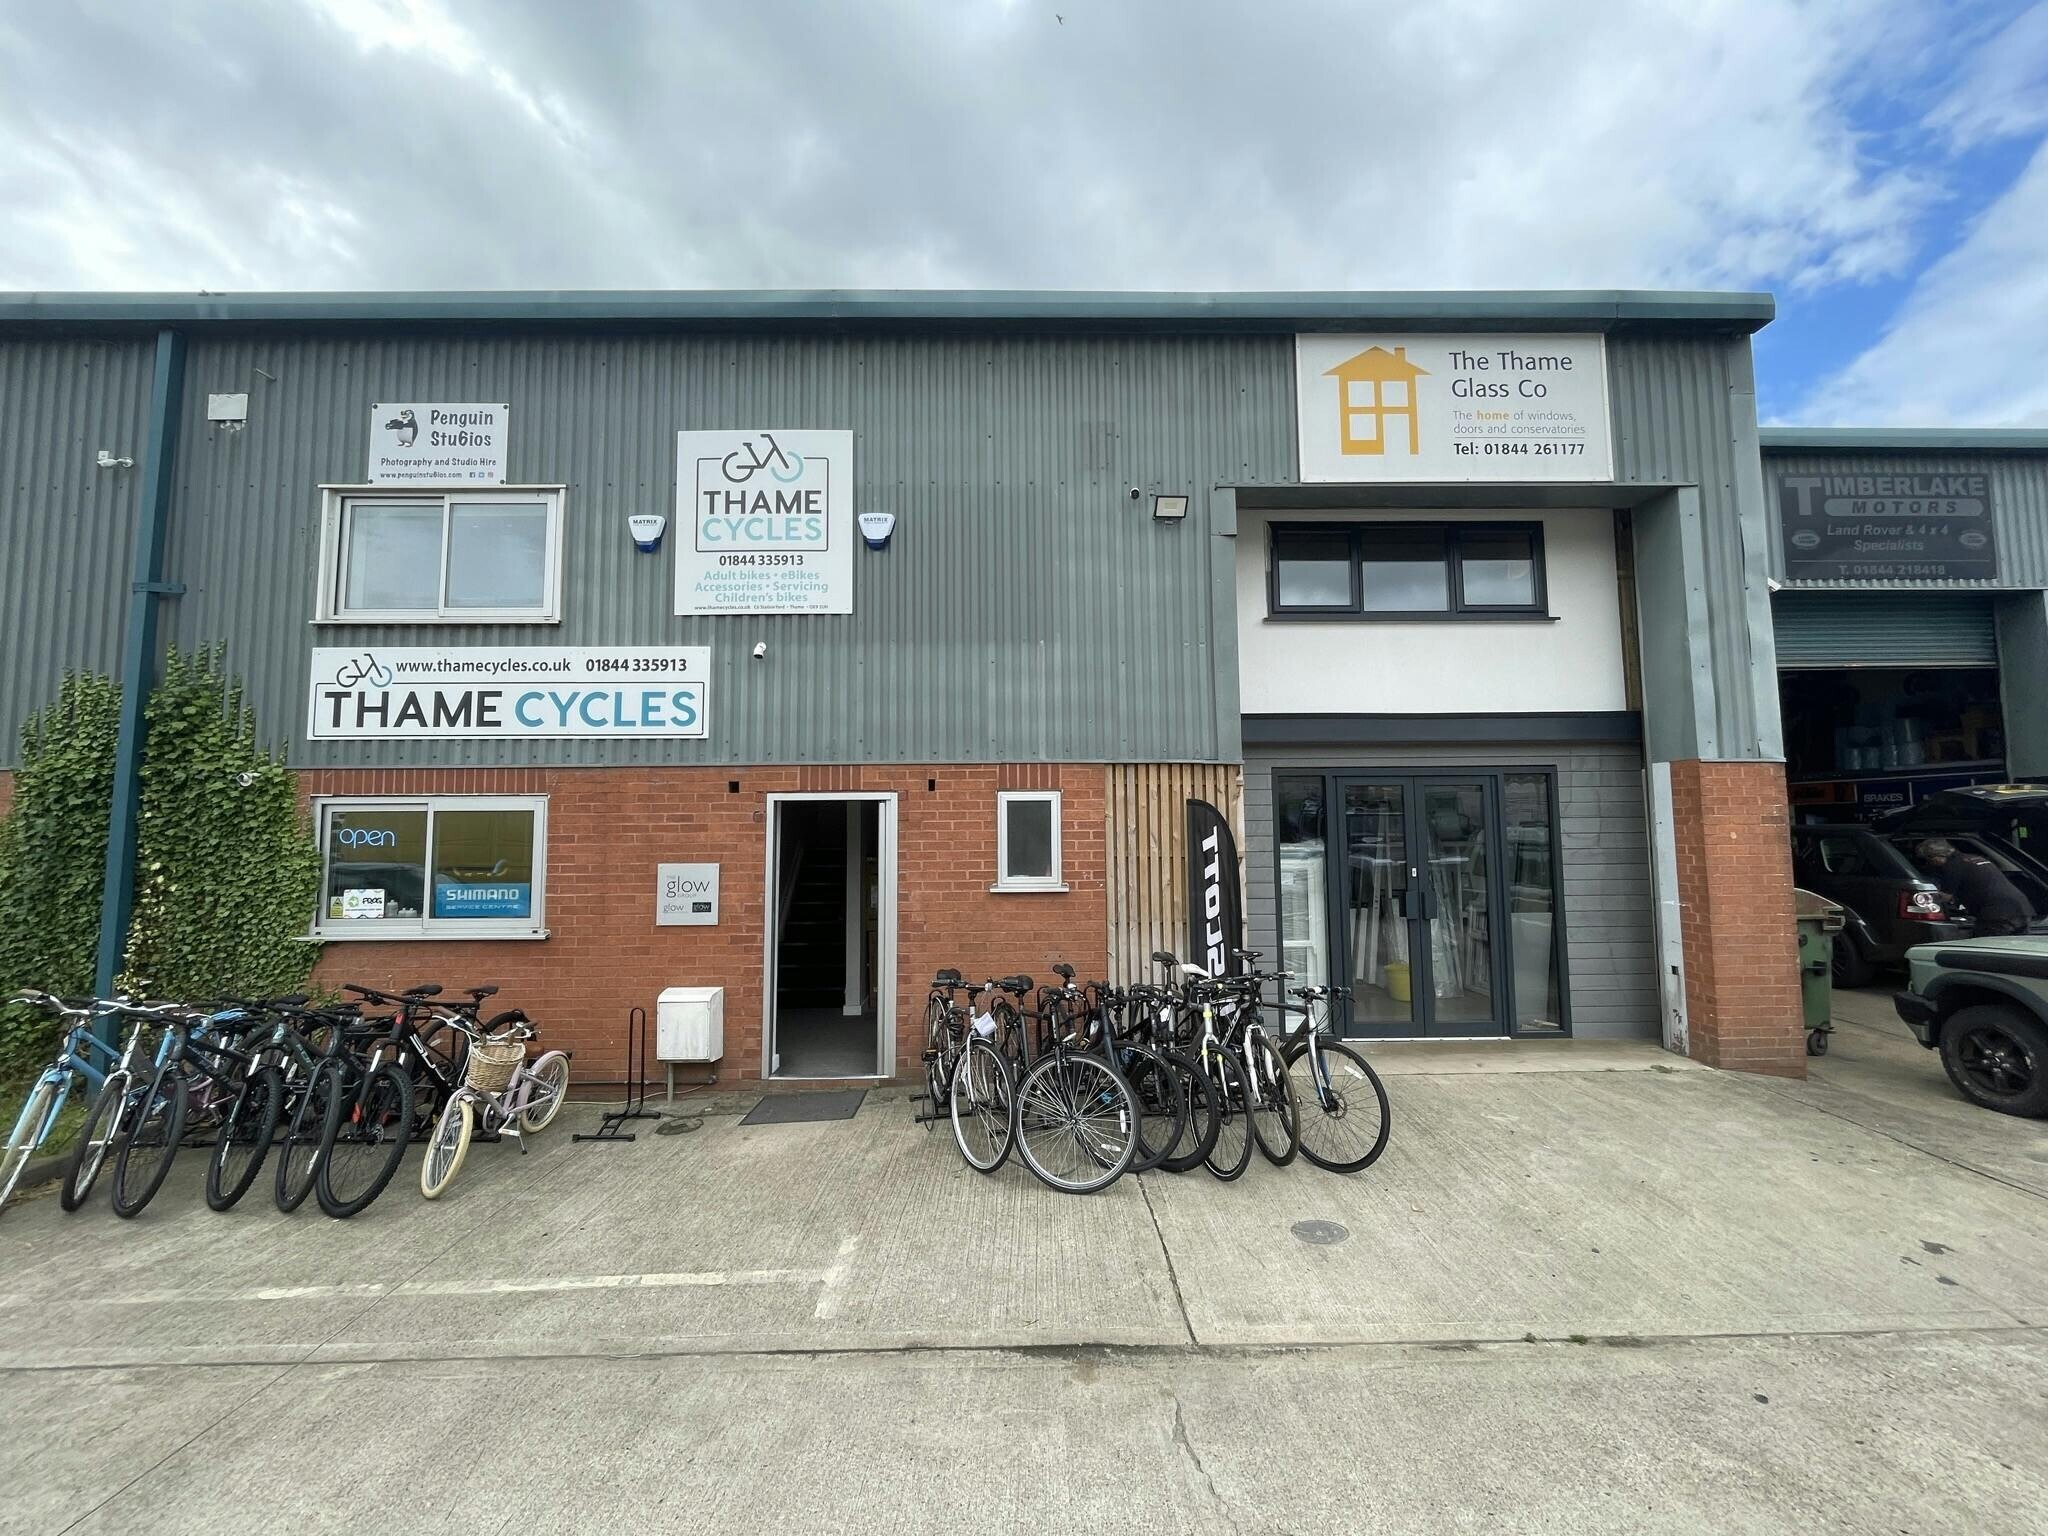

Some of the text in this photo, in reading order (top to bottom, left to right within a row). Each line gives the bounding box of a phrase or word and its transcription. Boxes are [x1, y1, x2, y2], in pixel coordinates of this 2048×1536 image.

[1449, 350, 1573, 371] The Thame
[1451, 377, 1547, 398] Glass Co
[430, 409, 493, 427] Penguin
[1452, 410, 1576, 422] The home of windows,
[1453, 423, 1586, 434] doors and conservatories
[430, 430, 492, 447] Stu6ios
[1453, 443, 1585, 455] Tel: 01844 261177
[380, 457, 497, 467] Photography and Studio Hire
[703, 490, 822, 515] THAME
[1784, 477, 1986, 516] TIMBERLAKE
[1851, 501, 1957, 514] MOTORS
[702, 517, 822, 541] CYCLES
[1827, 524, 1860, 536] Land
[1863, 524, 1901, 536] Rover
[1853, 539, 1924, 552] Specialists
[719, 555, 804, 566] 01844 335913
[704, 570, 820, 581] Adult bikes eBikes
[694, 581, 829, 593] Accessories Servicing
[714, 591, 808, 602] Children's bikes
[396, 657, 687, 676] www.thamecycles.co.uk 01844 335913
[324, 690, 697, 728] THAME CYCLES
[1863, 793, 1904, 802] BRAKES
[339, 828, 396, 848] open
[666, 876, 710, 898] glow
[446, 889, 519, 901] SHIMANO
